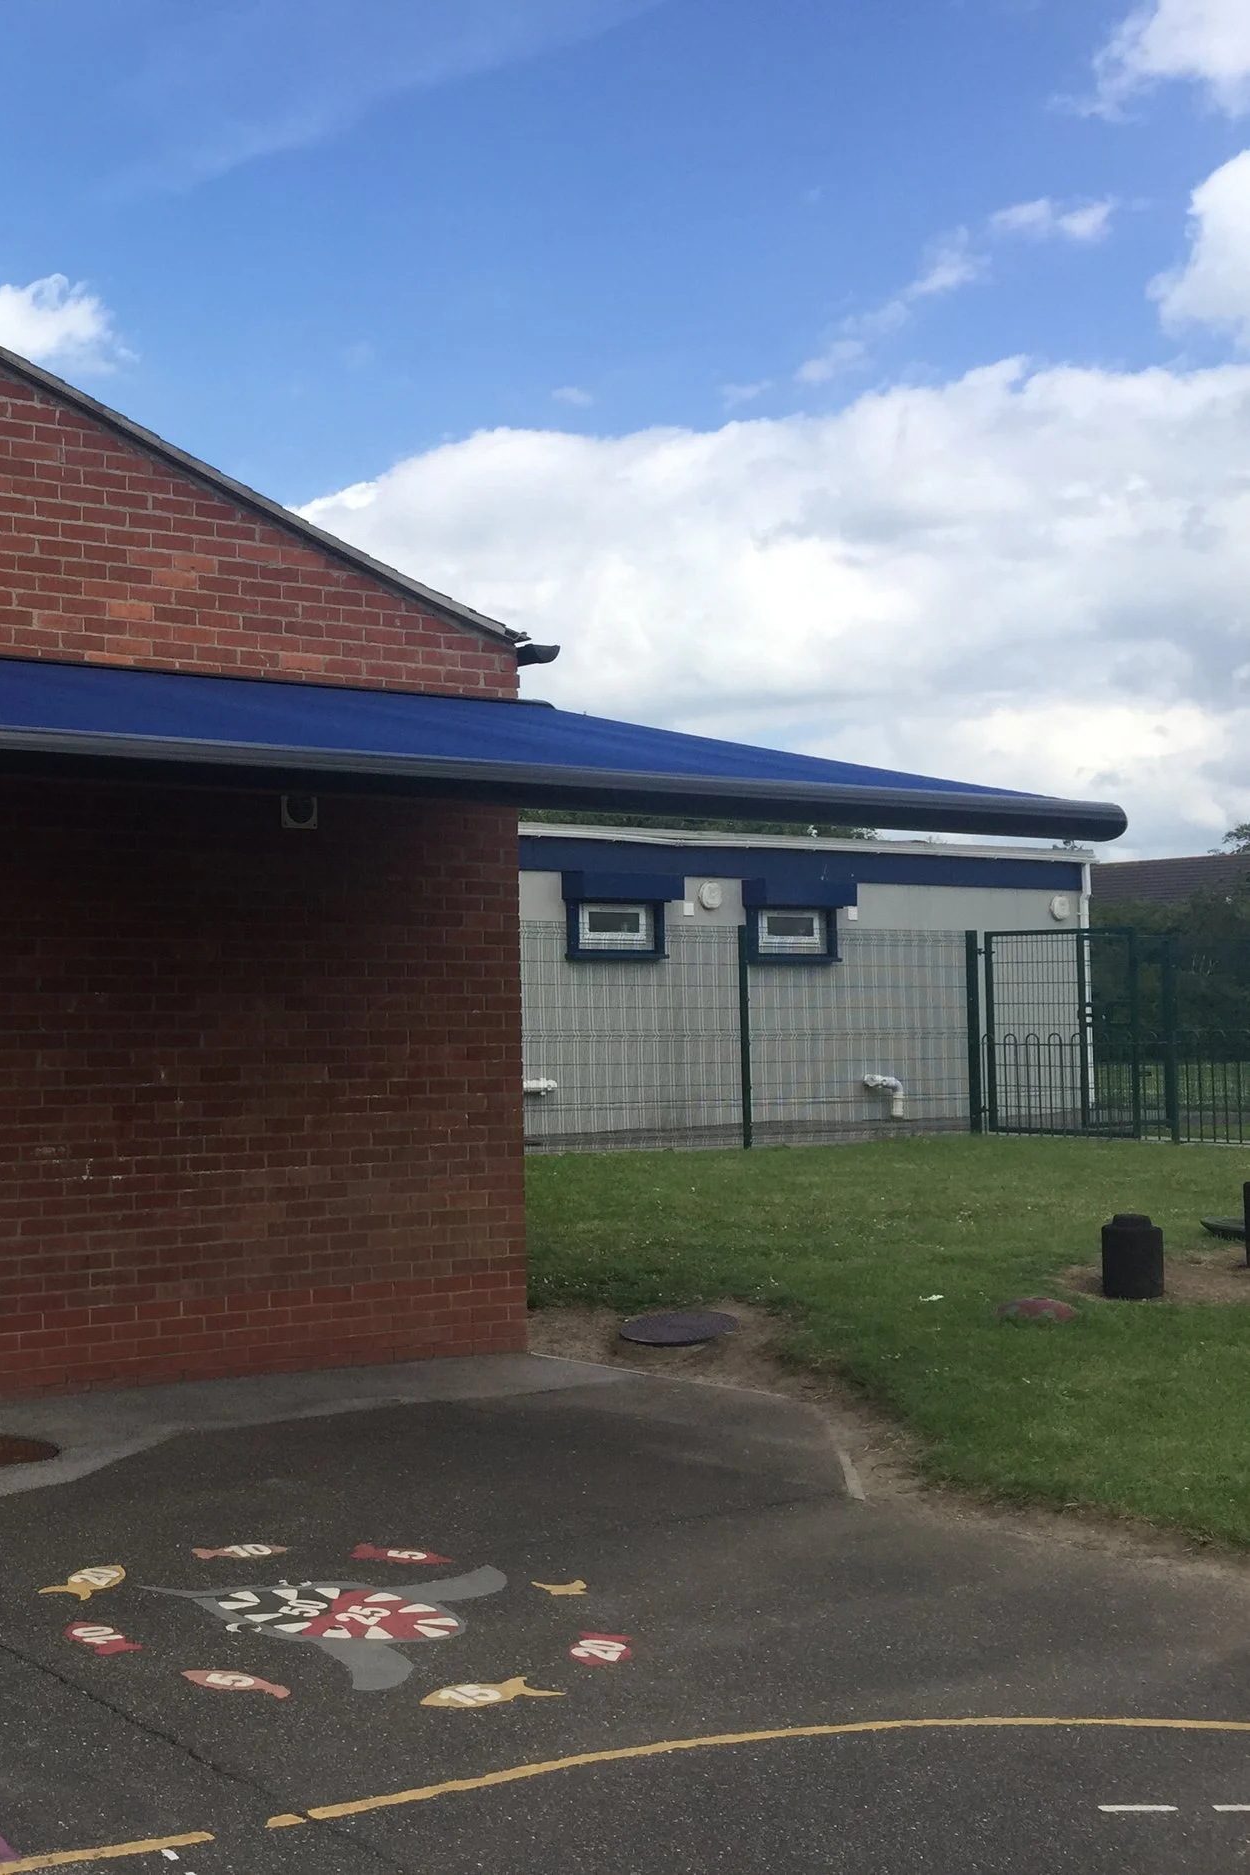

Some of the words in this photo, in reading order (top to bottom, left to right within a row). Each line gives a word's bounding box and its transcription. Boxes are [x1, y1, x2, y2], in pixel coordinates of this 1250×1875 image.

[224, 1544, 272, 1557] 10
[387, 1550, 427, 1560] 5
[70, 1568, 120, 1587] 20
[278, 1600, 328, 1617] 50
[335, 1605, 391, 1625] 25
[71, 1626, 124, 1644] 10
[571, 1639, 627, 1661] 20
[206, 1673, 255, 1687] 5
[437, 1684, 501, 1705] 15
